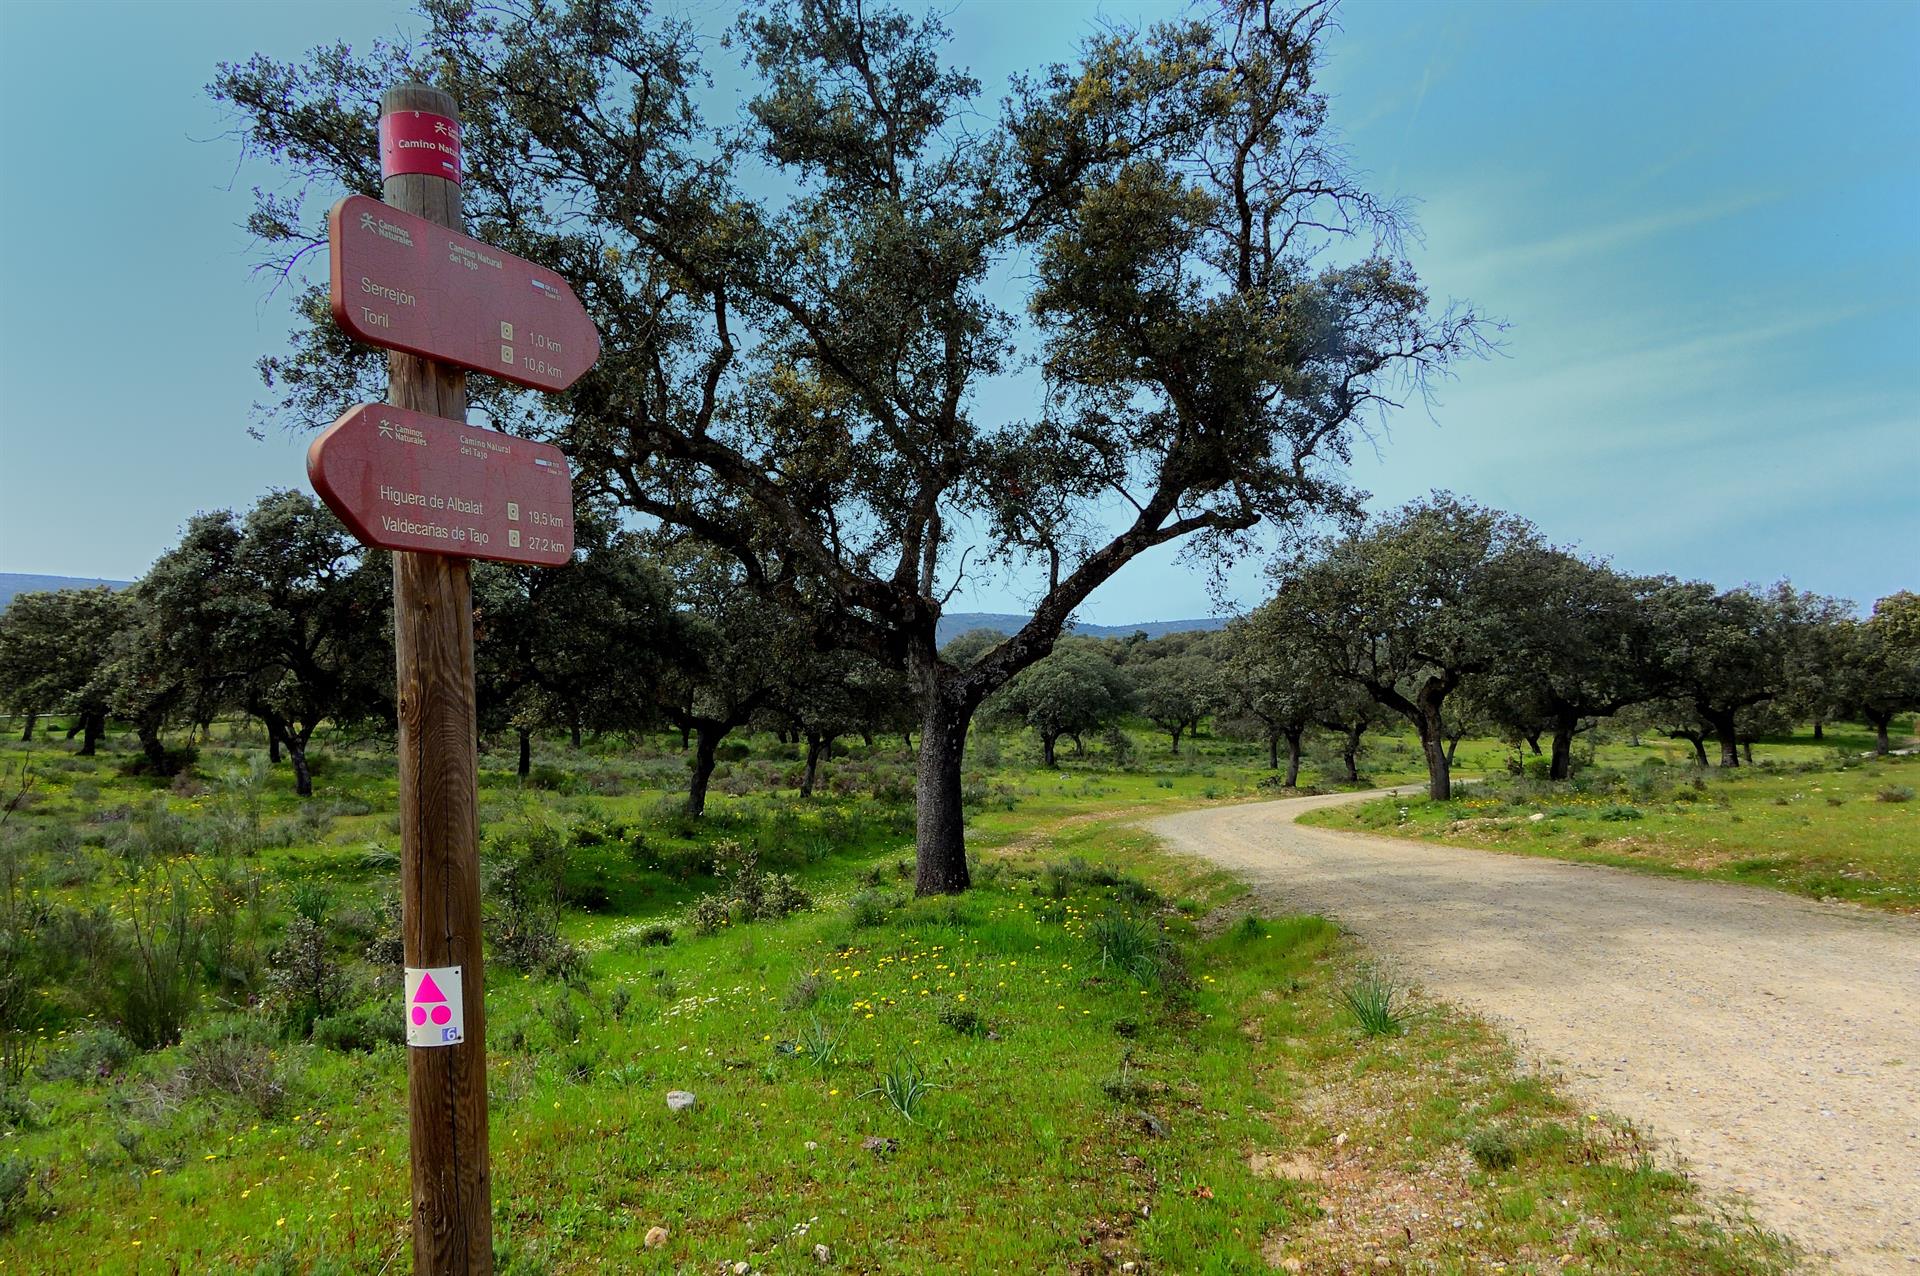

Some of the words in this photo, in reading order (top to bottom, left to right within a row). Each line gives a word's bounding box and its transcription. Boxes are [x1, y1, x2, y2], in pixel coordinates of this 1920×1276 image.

[399, 140, 436, 149] Camino
[378, 219, 409, 238] Caminos
[378, 227, 414, 247] Naturales
[448, 241, 476, 259] Camino
[477, 250, 503, 269] Natural
[449, 253, 462, 265] del
[462, 256, 479, 271] Tajo
[361, 277, 416, 307] Serrejón
[361, 306, 390, 329] Toril
[529, 332, 545, 349] 1,0
[546, 335, 562, 353] km
[523, 356, 546, 374] 10,6
[547, 360, 562, 379] km
[394, 424, 423, 438] Caminos
[395, 432, 427, 447] Naturales
[460, 435, 486, 448] Camino
[487, 440, 511, 455] Natural
[460, 446, 472, 456] del
[472, 448, 488, 460] Tajo
[380, 485, 427, 508] Higuera
[430, 493, 444, 509] de
[447, 496, 483, 515] Albalat
[528, 511, 548, 525] 19,5
[549, 511, 564, 528] km
[382, 515, 449, 538] Valdecañas
[451, 525, 465, 541] de
[468, 527, 489, 546] Tajo
[529, 536, 549, 552] 27,2
[551, 537, 565, 553] km
[447, 1028, 456, 1040] 6
